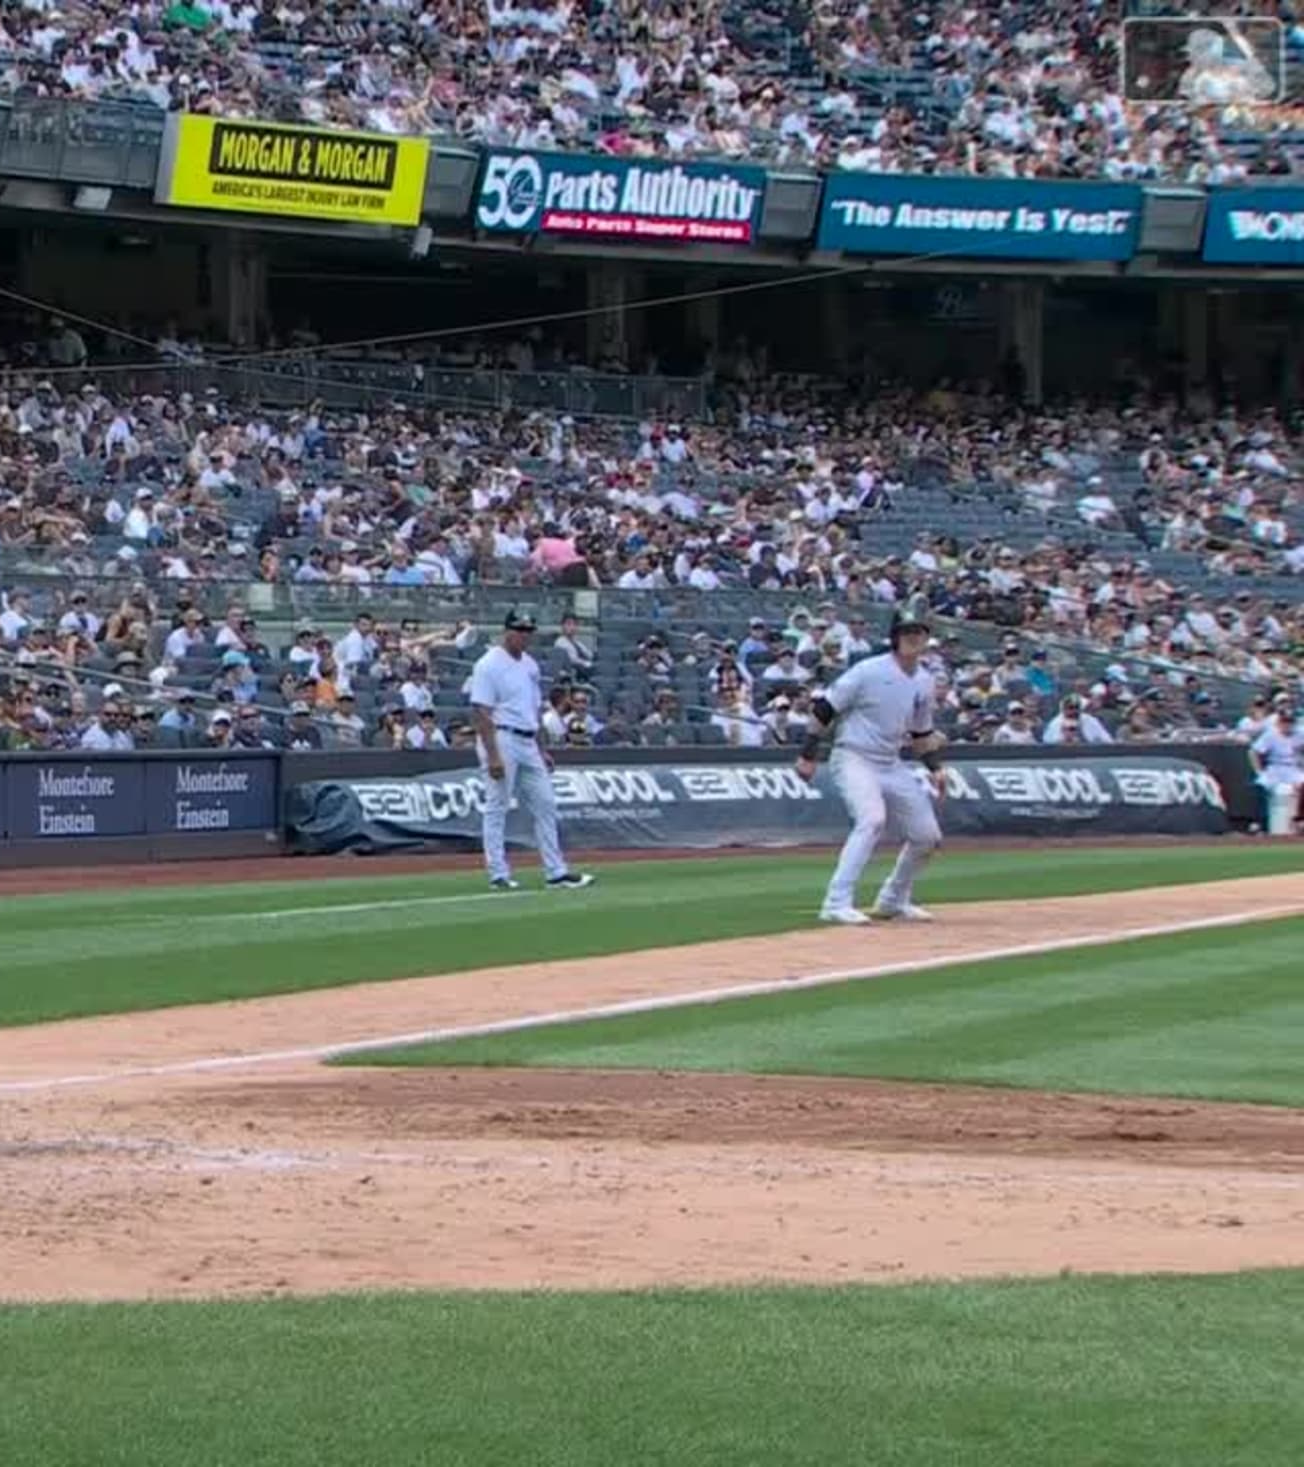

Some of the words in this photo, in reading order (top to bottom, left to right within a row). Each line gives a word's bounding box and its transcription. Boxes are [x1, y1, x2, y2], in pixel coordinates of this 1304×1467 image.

[218, 130, 295, 175] MORGAN
[297, 138, 312, 175] &
[314, 139, 389, 183] MORGAN
[211, 179, 263, 199] AMERICA'S
[264, 184, 306, 204] LARGEST
[307, 188, 339, 207] INJURY
[340, 192, 361, 209] LAW
[362, 194, 387, 211] FIRM
[545, 169, 618, 211] Parts
[619, 165, 756, 221] Authority
[546, 213, 584, 230] Auto
[586, 216, 632, 232] Parts
[634, 218, 687, 236] Super
[688, 222, 744, 239] Stores
[895, 203, 1010, 231] Answer
[1015, 207, 1046, 232] Is
[37, 765, 116, 797] Montefiore
[175, 761, 250, 793] Montefiore
[584, 769, 676, 803] COOL
[1036, 766, 1112, 804] COOL
[38, 803, 96, 834] Einstein
[176, 799, 230, 830] Einstein
